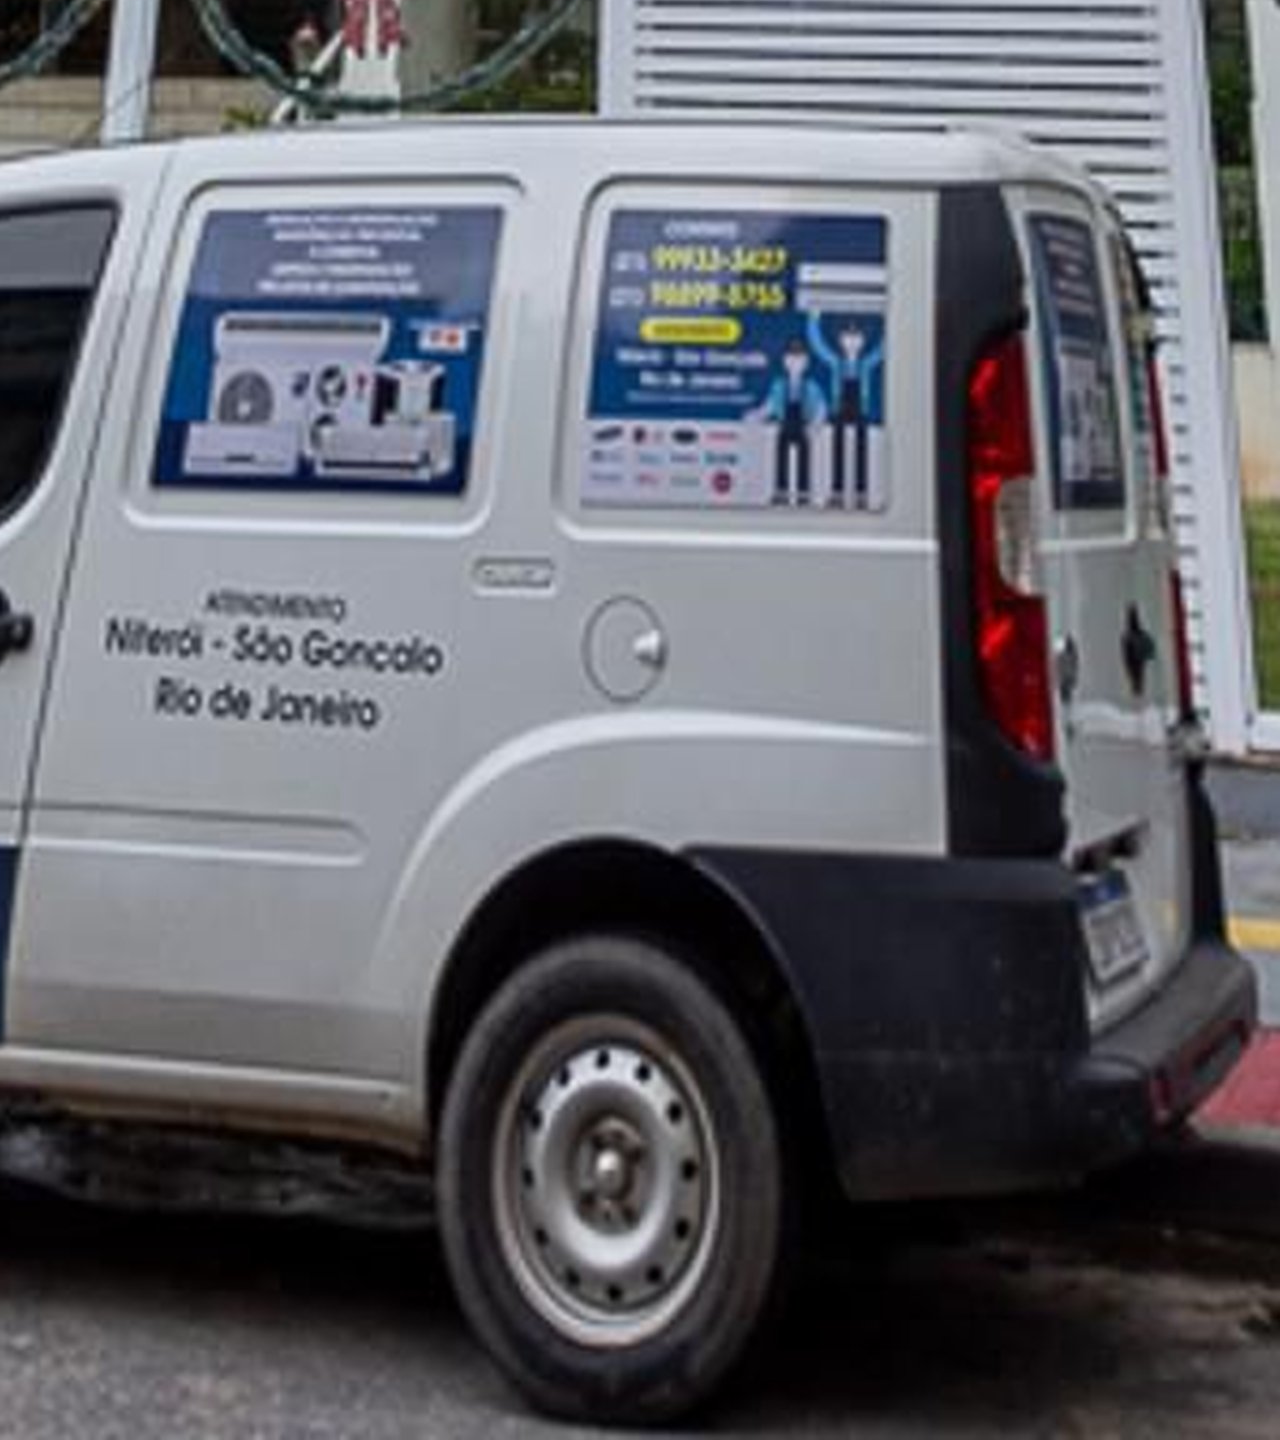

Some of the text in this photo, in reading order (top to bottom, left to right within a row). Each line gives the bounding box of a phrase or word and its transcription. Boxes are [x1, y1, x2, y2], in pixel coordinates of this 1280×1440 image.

[155, 677, 377, 729] Rio de Janeiro
